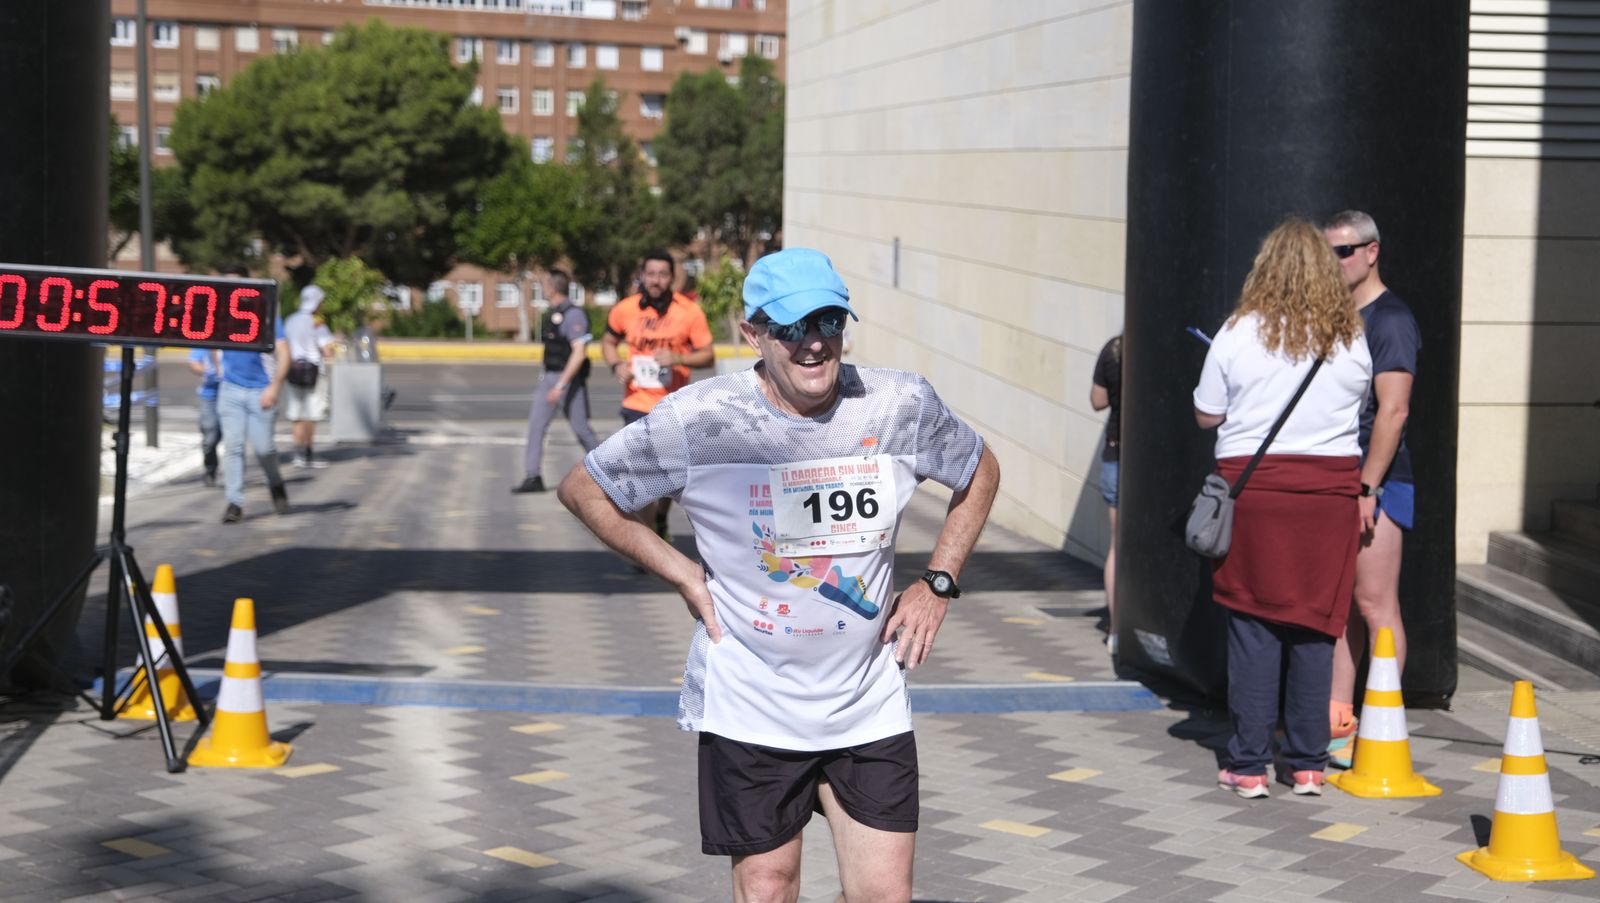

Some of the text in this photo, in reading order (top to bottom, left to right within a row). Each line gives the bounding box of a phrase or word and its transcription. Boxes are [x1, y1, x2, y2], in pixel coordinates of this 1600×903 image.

[790, 467, 836, 481] CARRERA
[838, 465, 855, 475] SIN
[803, 488, 879, 524] 196
